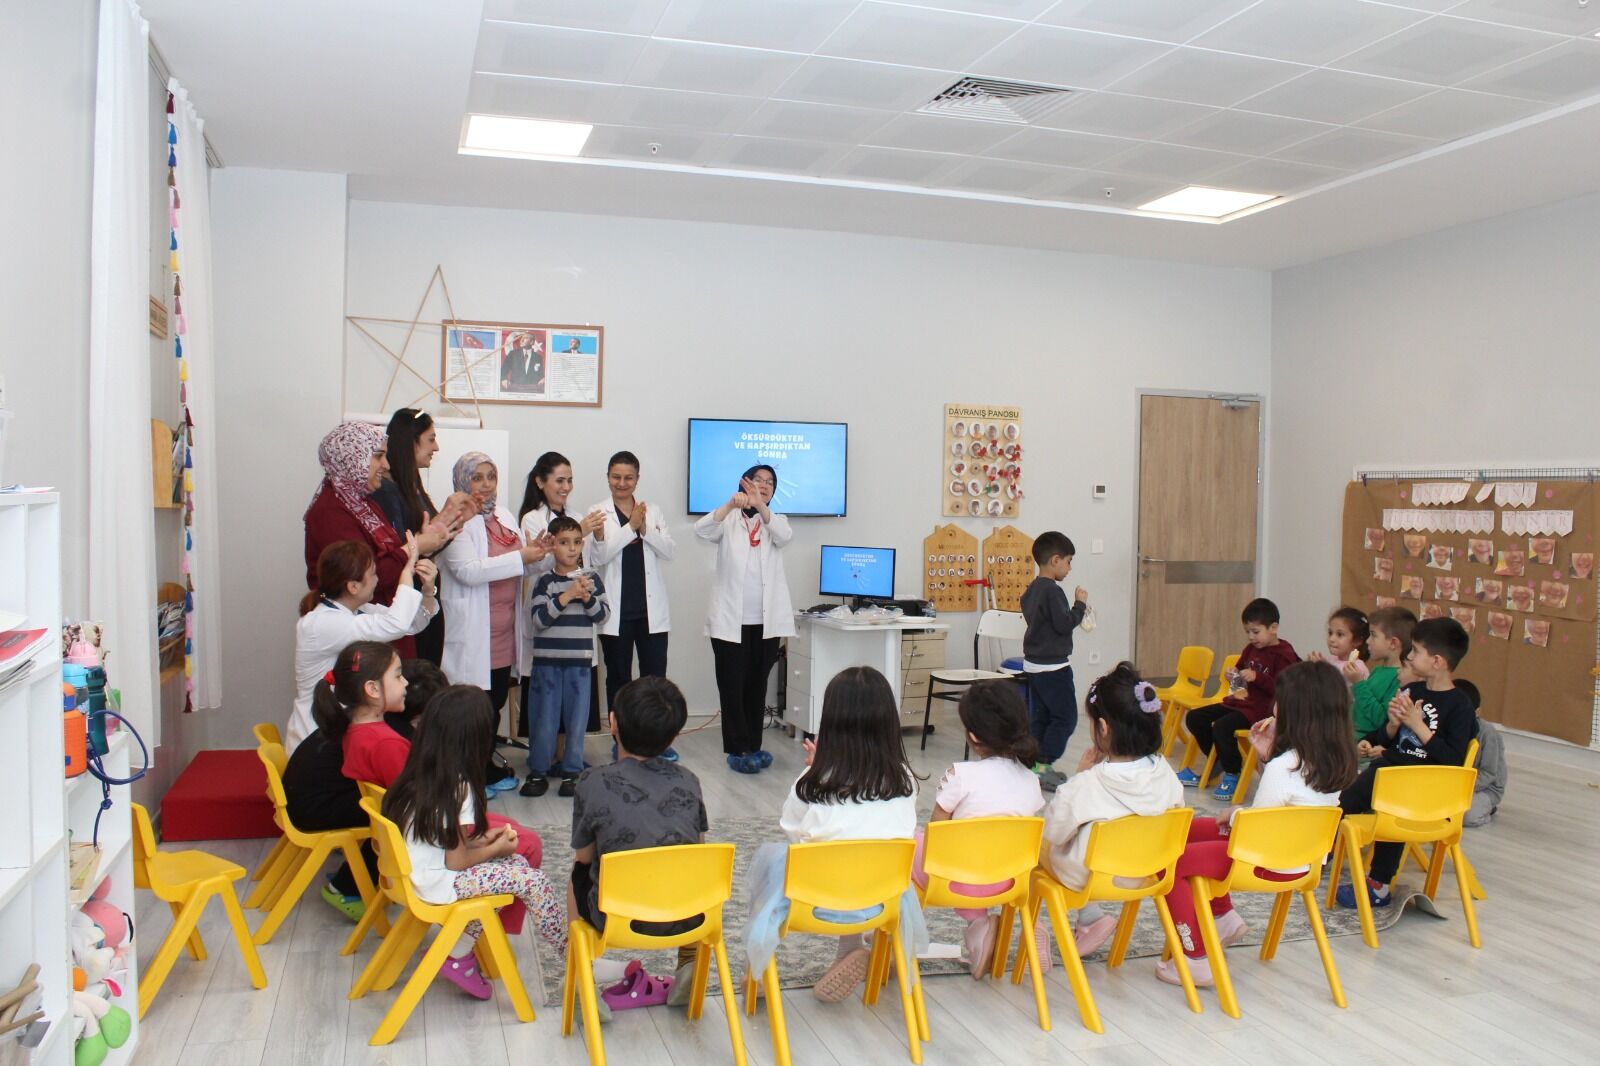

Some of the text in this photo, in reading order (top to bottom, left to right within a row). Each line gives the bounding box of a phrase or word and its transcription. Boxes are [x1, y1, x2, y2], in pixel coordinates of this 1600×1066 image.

[948, 408, 1020, 418] DAVRANIŞ PANOSU
[741, 431, 804, 442] ÖKSÜRDÜKTEN
[734, 441, 811, 450] VE HAPŞIRDIKTAN
[757, 449, 787, 459] SONRA
[1423, 703, 1439, 734] GIAN
